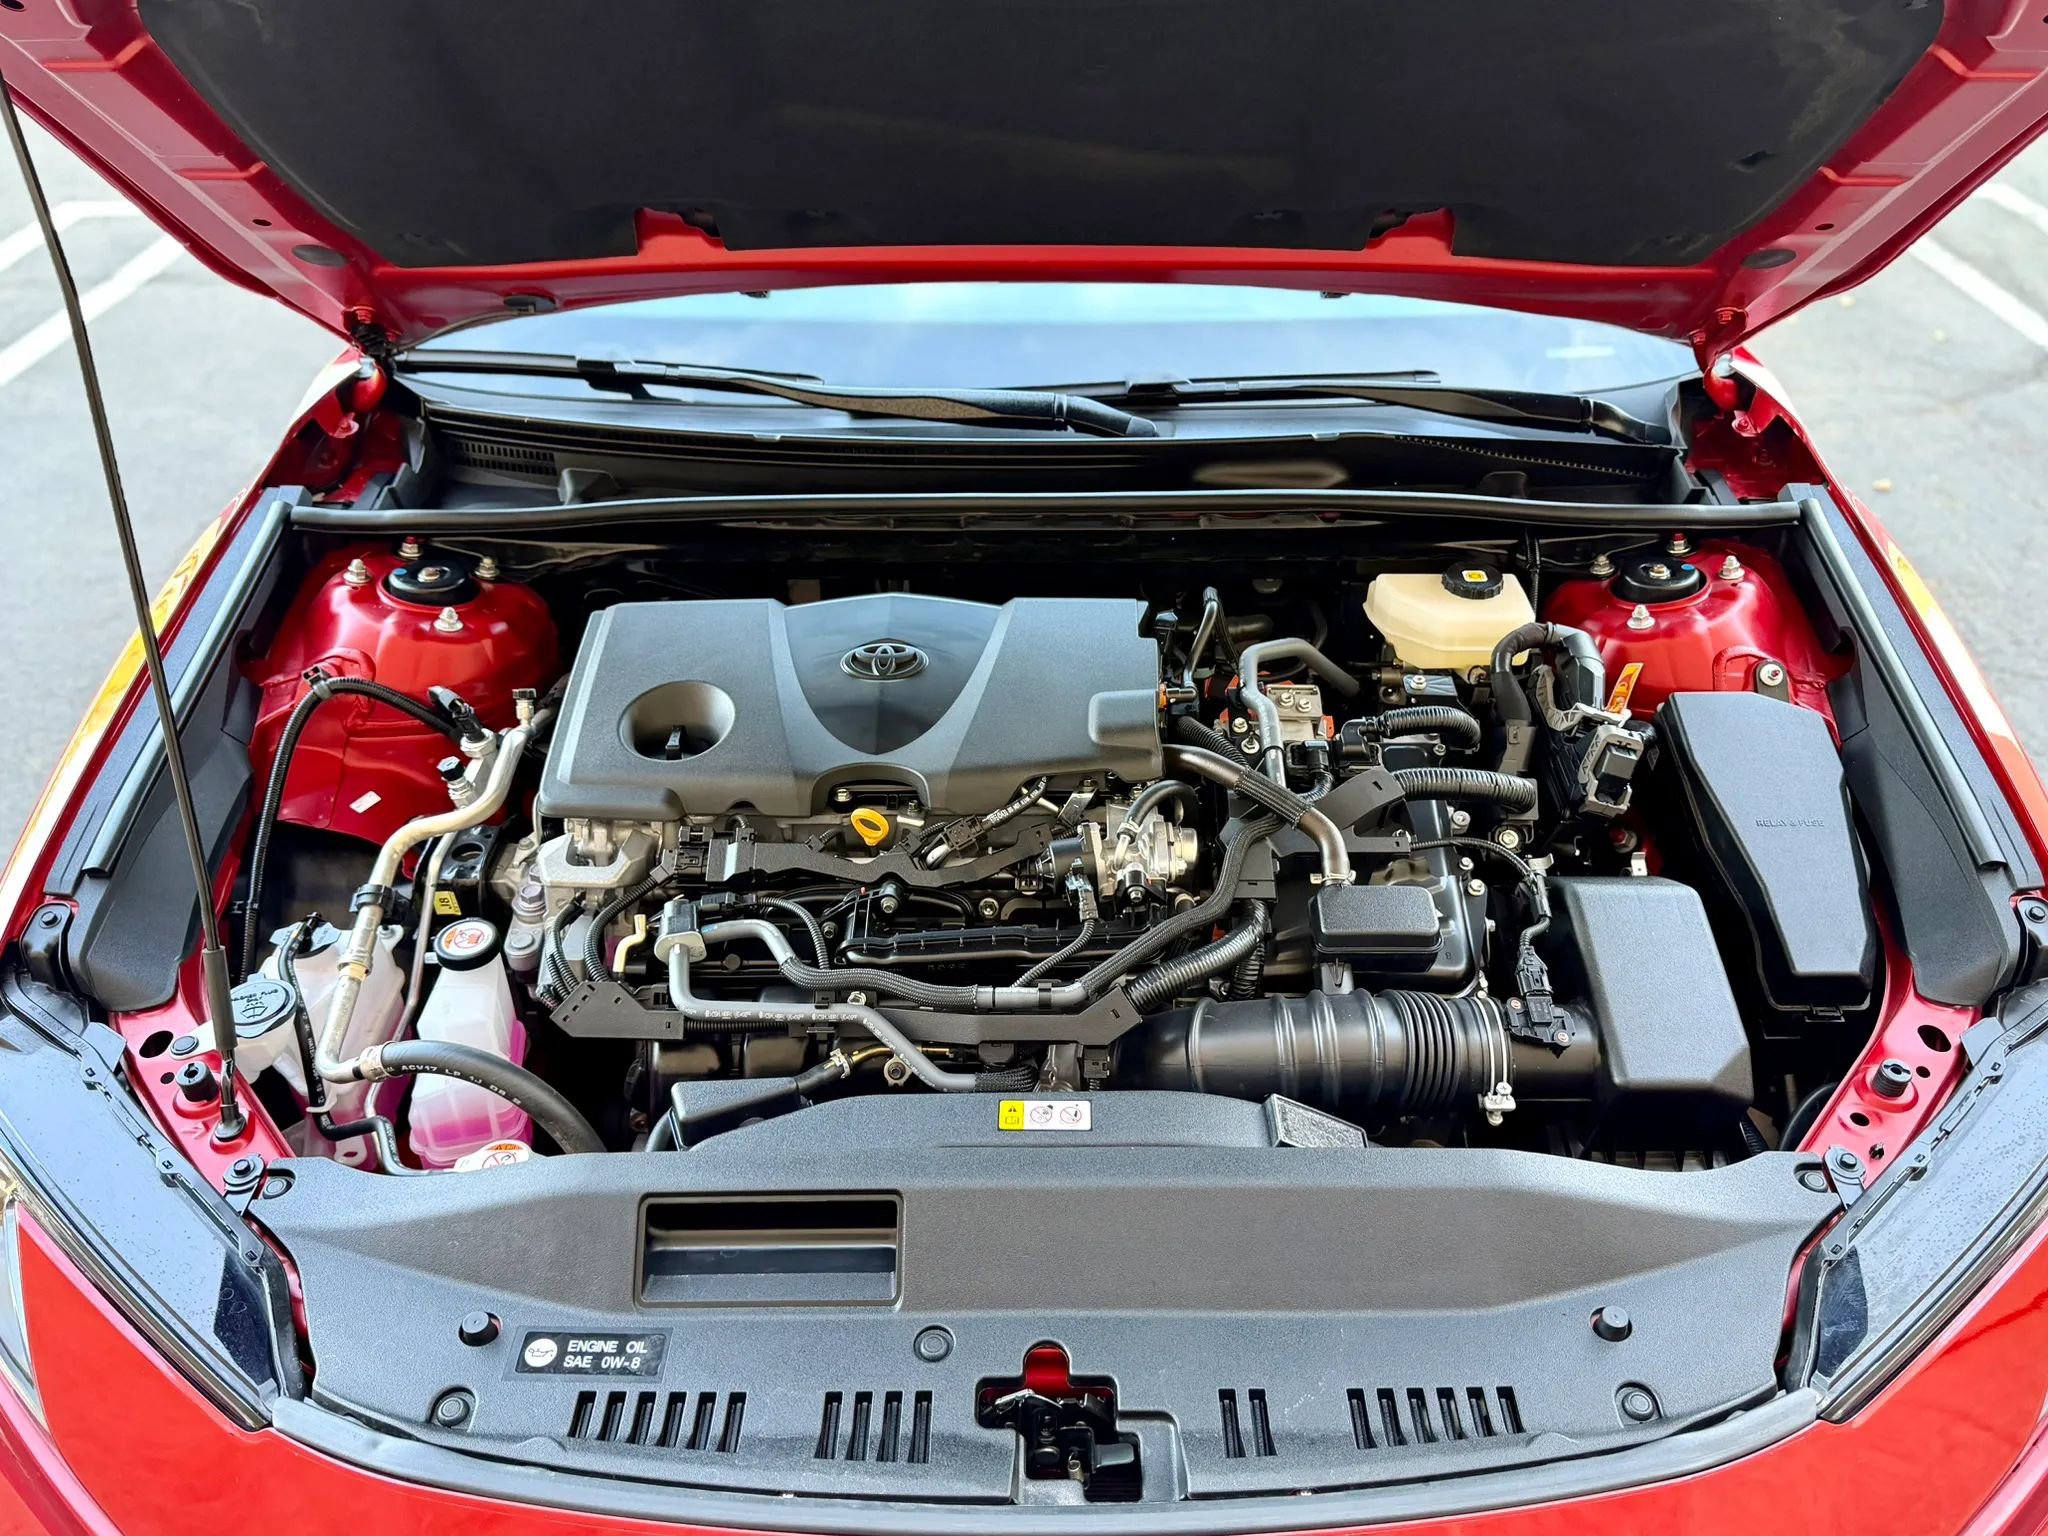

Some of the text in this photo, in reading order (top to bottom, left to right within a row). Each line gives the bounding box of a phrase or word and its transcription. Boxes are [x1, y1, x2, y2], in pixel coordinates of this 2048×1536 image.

[567, 1340, 648, 1354] ENGINE OIL
[563, 1355, 641, 1369] SAE 0W-8
